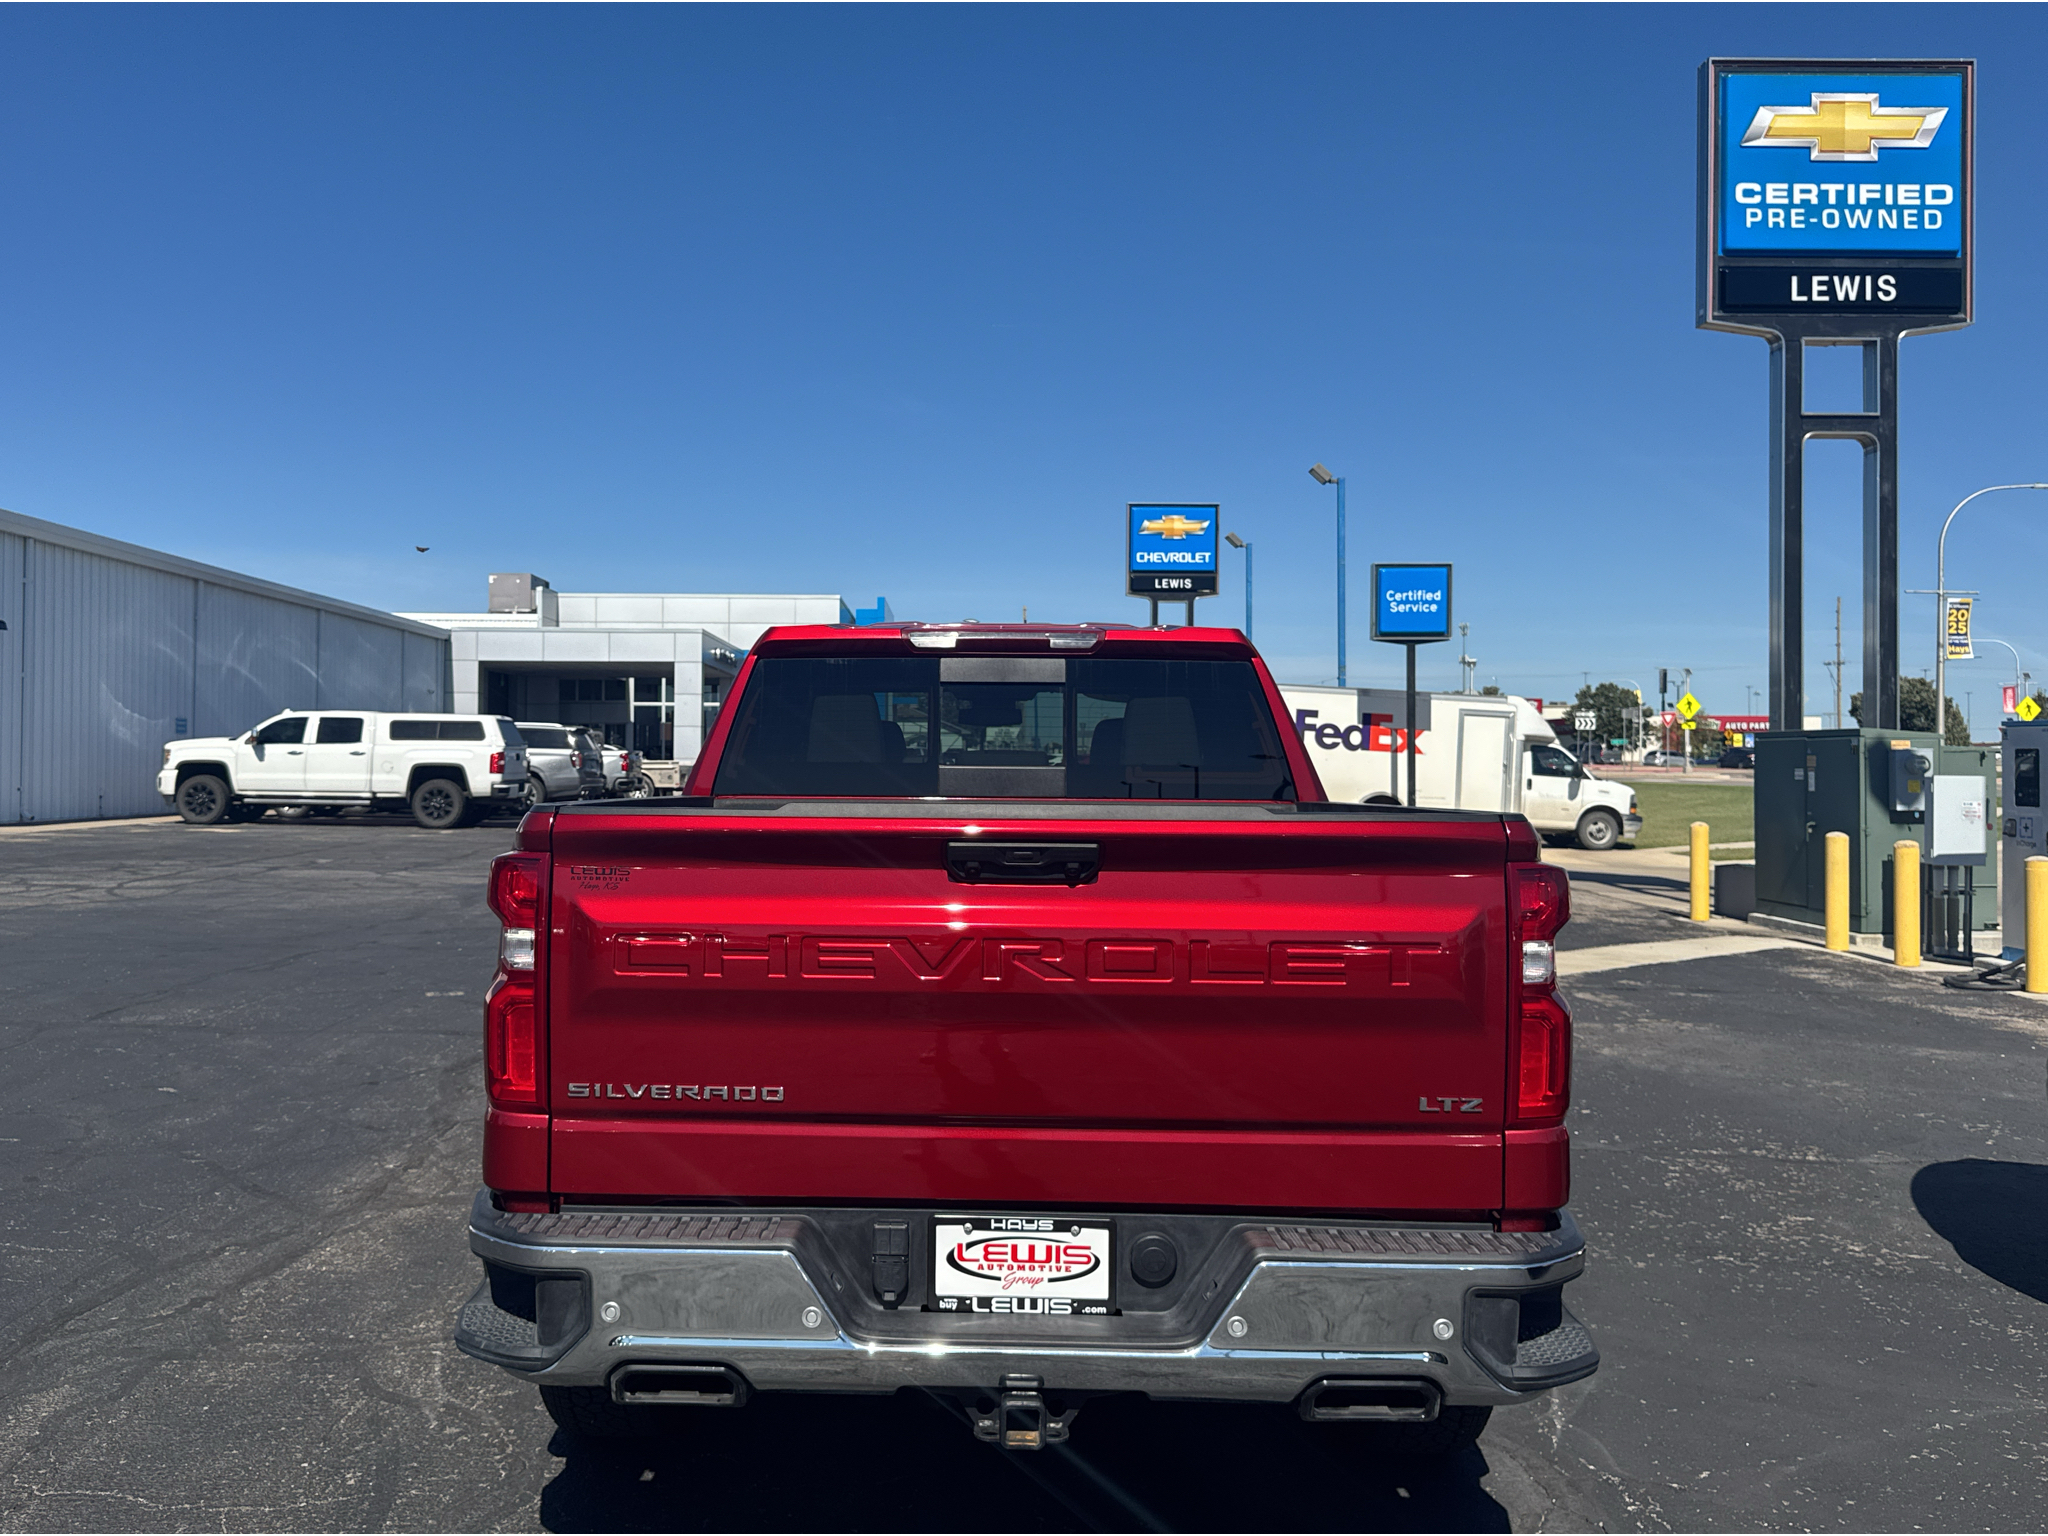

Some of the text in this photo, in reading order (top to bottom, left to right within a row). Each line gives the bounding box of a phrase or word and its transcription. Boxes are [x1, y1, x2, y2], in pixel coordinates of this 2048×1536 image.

[1734, 182, 1954, 205] CERTIFIED
[1745, 207, 1943, 230] PRE-OWNED
[1791, 274, 1897, 302] LEWIS
[1135, 551, 1212, 563] CHEVROLET
[1154, 578, 1193, 589] LEWIS
[1385, 589, 1442, 601] Certified
[1389, 601, 1438, 613] Service
[1295, 708, 1425, 755] FedEx
[1725, 721, 1748, 730] AUTO
[570, 866, 630, 876] LEWIS
[613, 931, 1443, 987] CHEVROLET
[567, 1082, 785, 1102] SILVERADO
[1419, 1096, 1484, 1112] LTZ
[990, 1218, 1054, 1231] HAYS
[956, 1242, 1092, 1265] LEWIS
[977, 1263, 1072, 1273] AUTOMOTIVE
[1001, 1271, 1045, 1290] Group
[938, 1296, 1107, 1315] buy LEWIS .com
